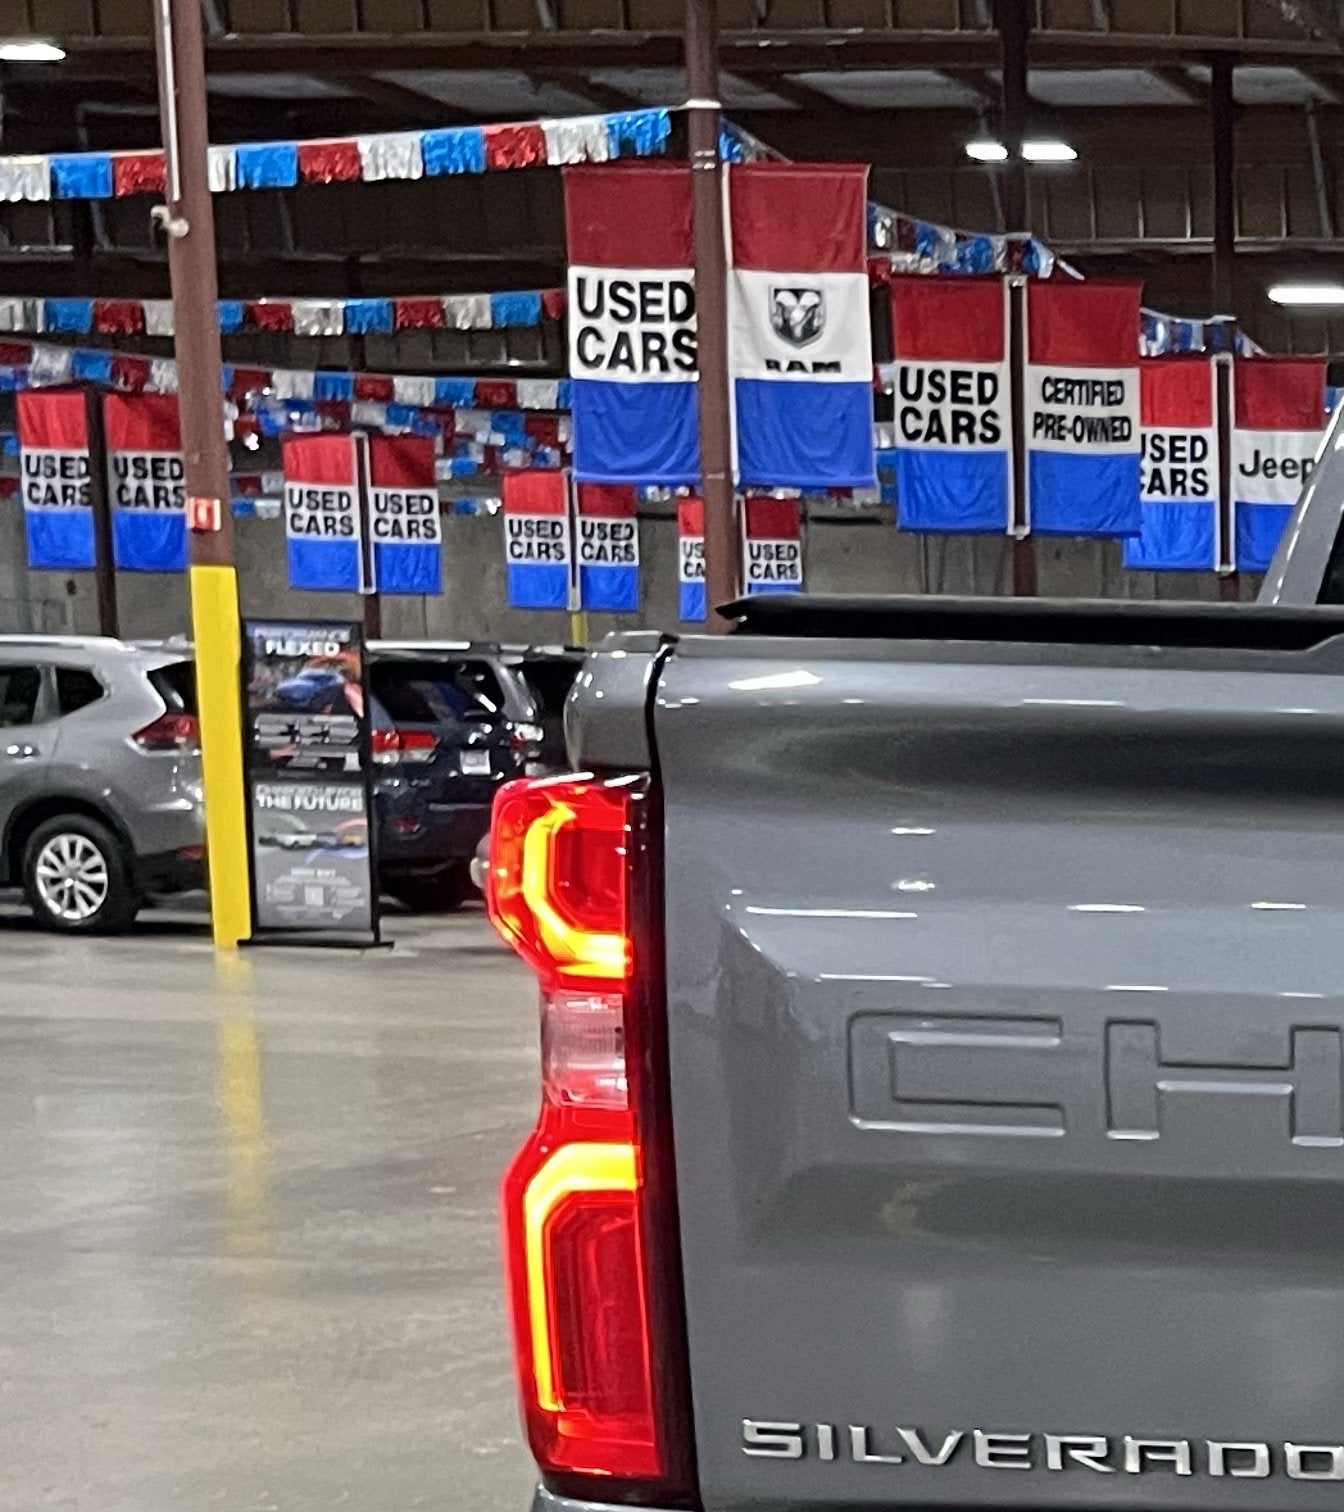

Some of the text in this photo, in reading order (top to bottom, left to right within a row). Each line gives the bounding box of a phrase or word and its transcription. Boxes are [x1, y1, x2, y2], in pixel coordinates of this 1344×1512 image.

[577, 278, 695, 322] USED
[577, 326, 697, 373] CARS
[765, 359, 841, 373] RAM
[900, 367, 998, 405] USED
[1042, 376, 1125, 406] CERTIFIED
[900, 406, 1000, 444] CARS
[1033, 411, 1131, 443] PRE-OWNED
[25, 455, 91, 478] USED
[114, 456, 184, 481] USED
[27, 482, 91, 506] CARS
[1141, 468, 1209, 496] ARS
[117, 484, 186, 509] CARS
[289, 488, 352, 512] USED
[375, 493, 434, 515] USED
[290, 513, 354, 537] CARS
[374, 517, 436, 539] CARS
[508, 519, 564, 539] USED
[581, 521, 634, 541] USED
[509, 541, 565, 561] CARS
[580, 542, 636, 562] CARS
[749, 543, 798, 561] USED
[749, 563, 799, 580] CARS
